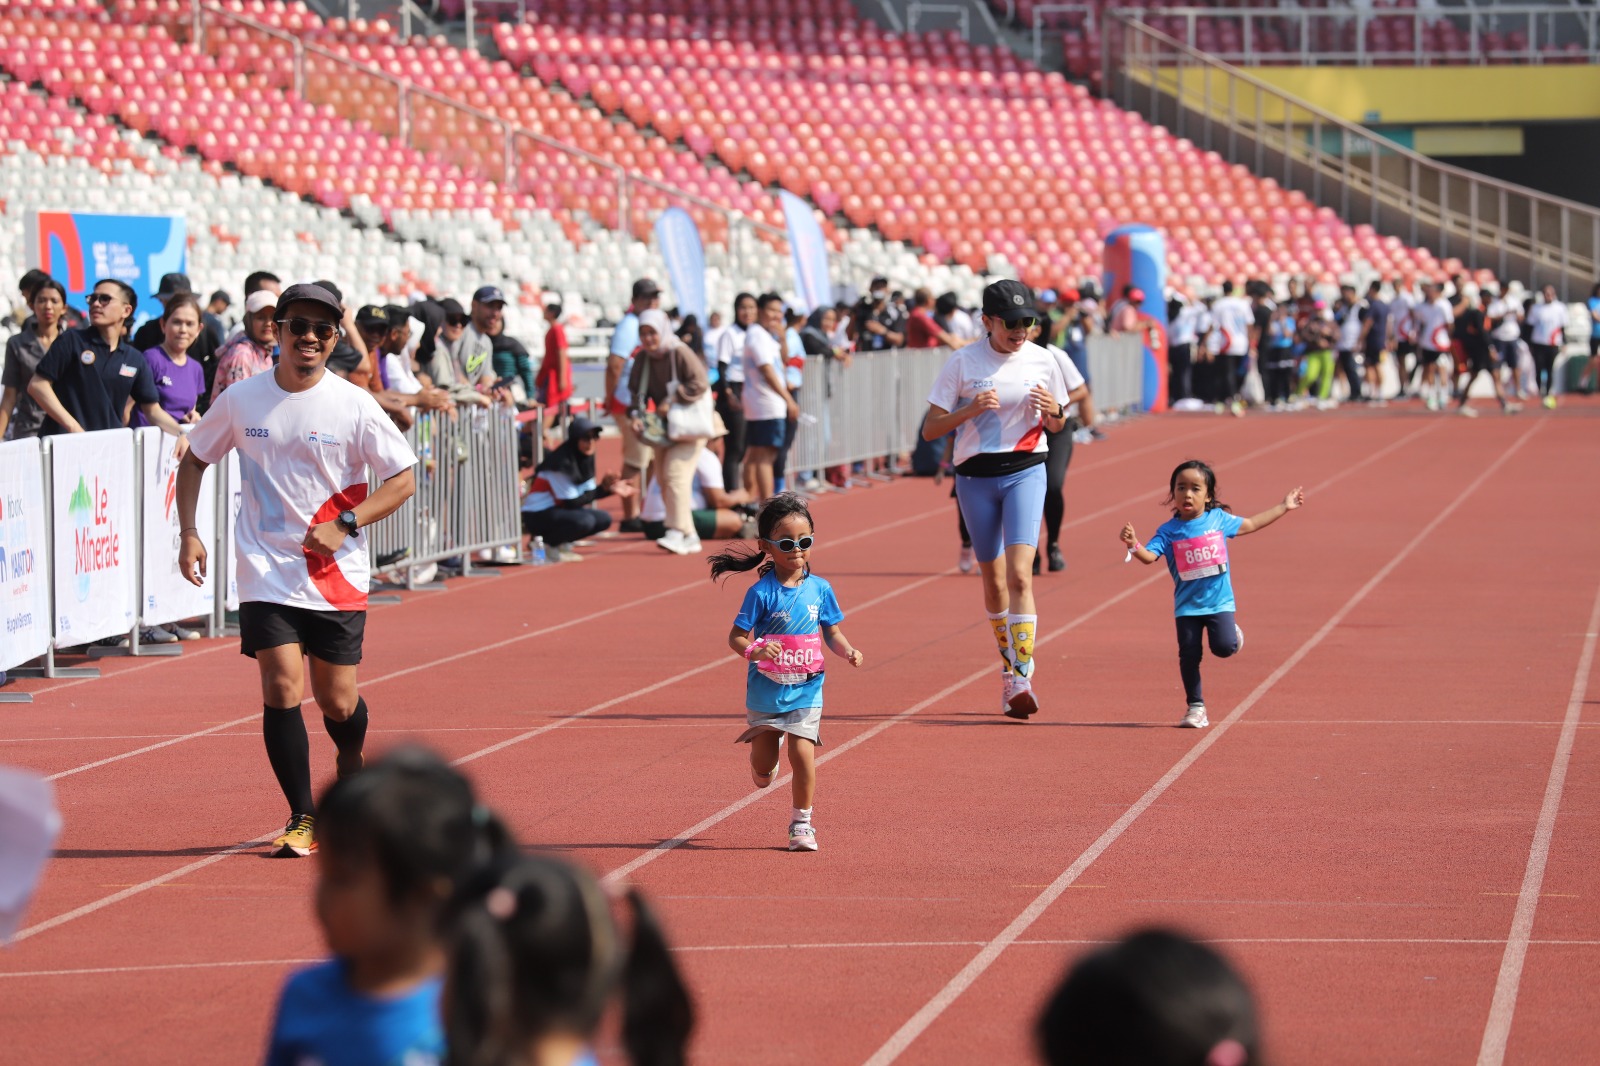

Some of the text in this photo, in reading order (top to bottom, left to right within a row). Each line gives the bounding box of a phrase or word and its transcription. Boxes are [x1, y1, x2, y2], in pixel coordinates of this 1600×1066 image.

[245, 428, 269, 437] 2023
[95, 475, 108, 525] Le
[75, 521, 119, 575] Minerale
[1185, 544, 1220, 564] 8662
[773, 648, 814, 666] 8660
